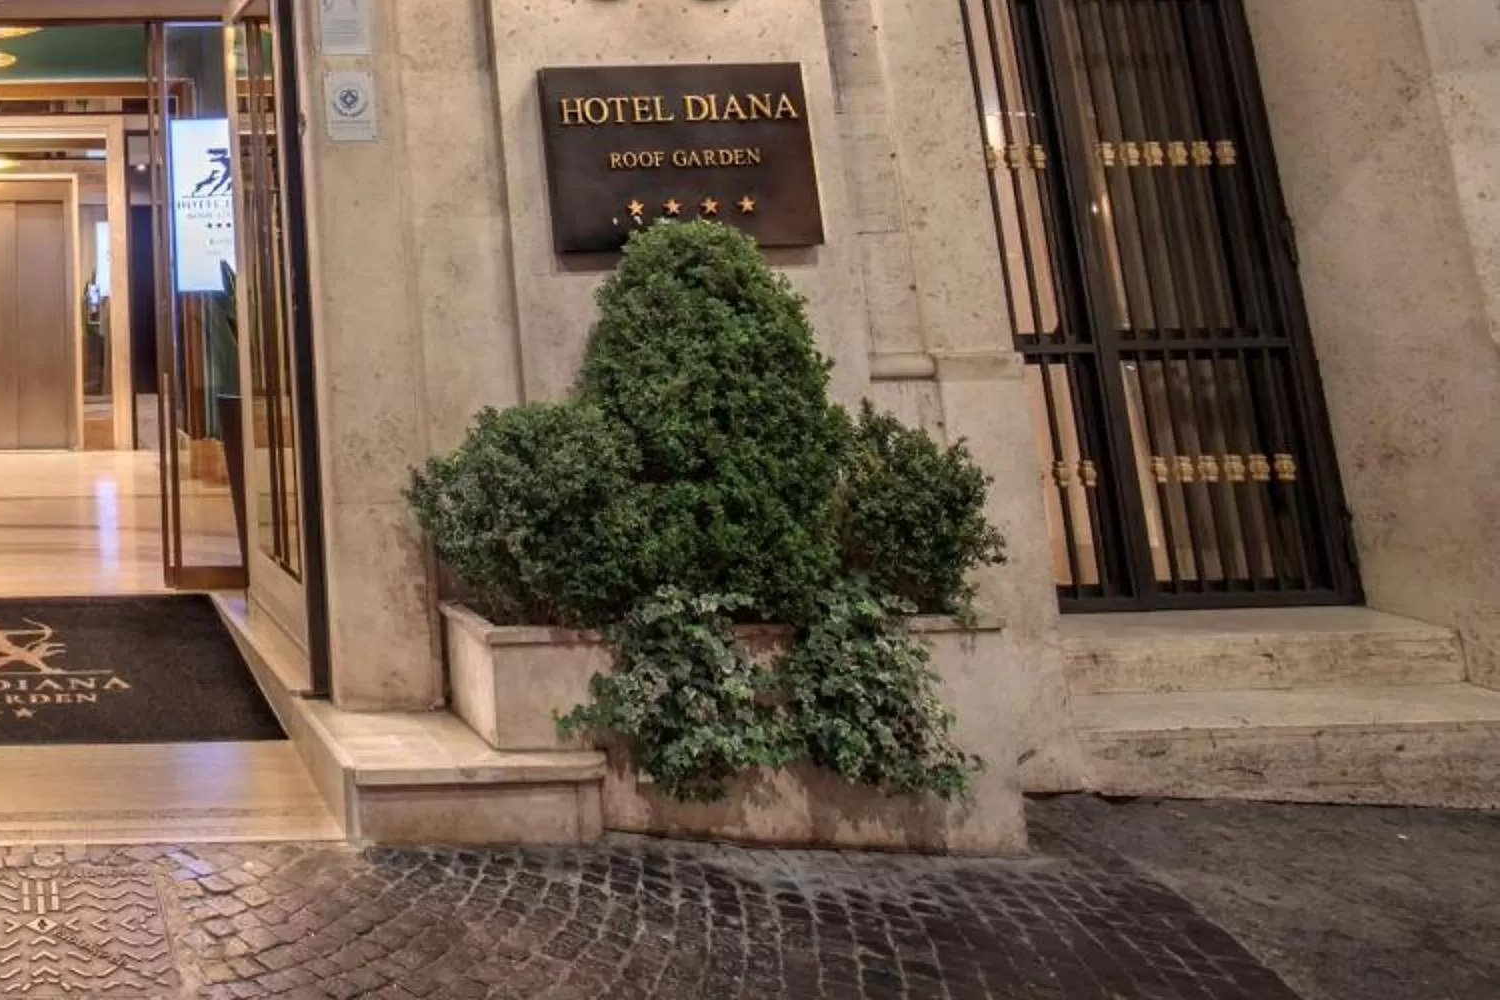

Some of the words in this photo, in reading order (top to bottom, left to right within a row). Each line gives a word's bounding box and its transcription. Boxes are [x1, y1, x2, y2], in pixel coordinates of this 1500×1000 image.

[560, 95, 675, 125] HOTEL
[683, 92, 798, 122] DIANA
[609, 150, 665, 169] ROOF
[672, 147, 762, 167] GARDEN
